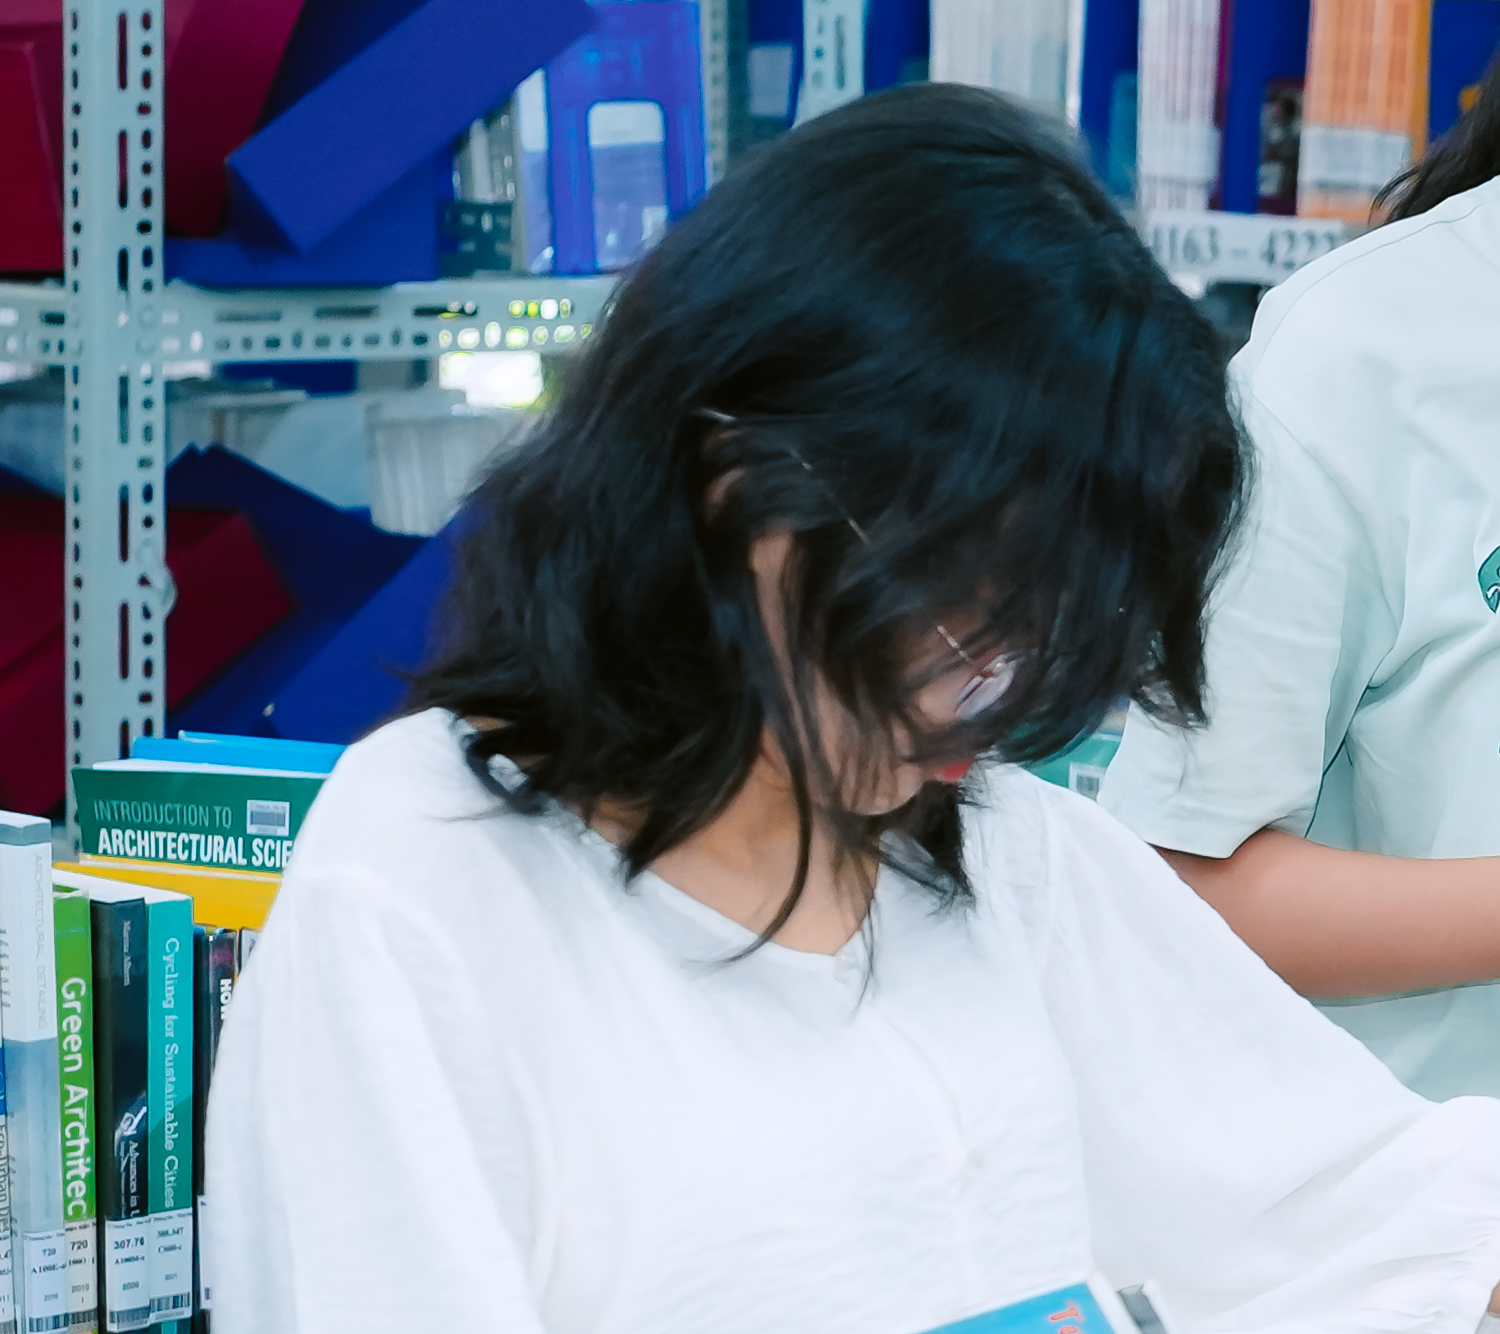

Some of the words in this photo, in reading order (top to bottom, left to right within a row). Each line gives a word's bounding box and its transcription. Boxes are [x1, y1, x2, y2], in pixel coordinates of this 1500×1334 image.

[94, 800, 210, 828] INTRODUCTION
[214, 805, 233, 830] TO
[98, 827, 248, 866] ARCHITECTURAL
[162, 937, 180, 1009] Cycling
[60, 976, 87, 1073] Green
[164, 1015, 179, 1039] for
[164, 1043, 180, 1151] Sustainable
[63, 1083, 91, 1216] Architec
[163, 1155, 179, 1209] Cities
[70, 1239, 89, 1251] 720
